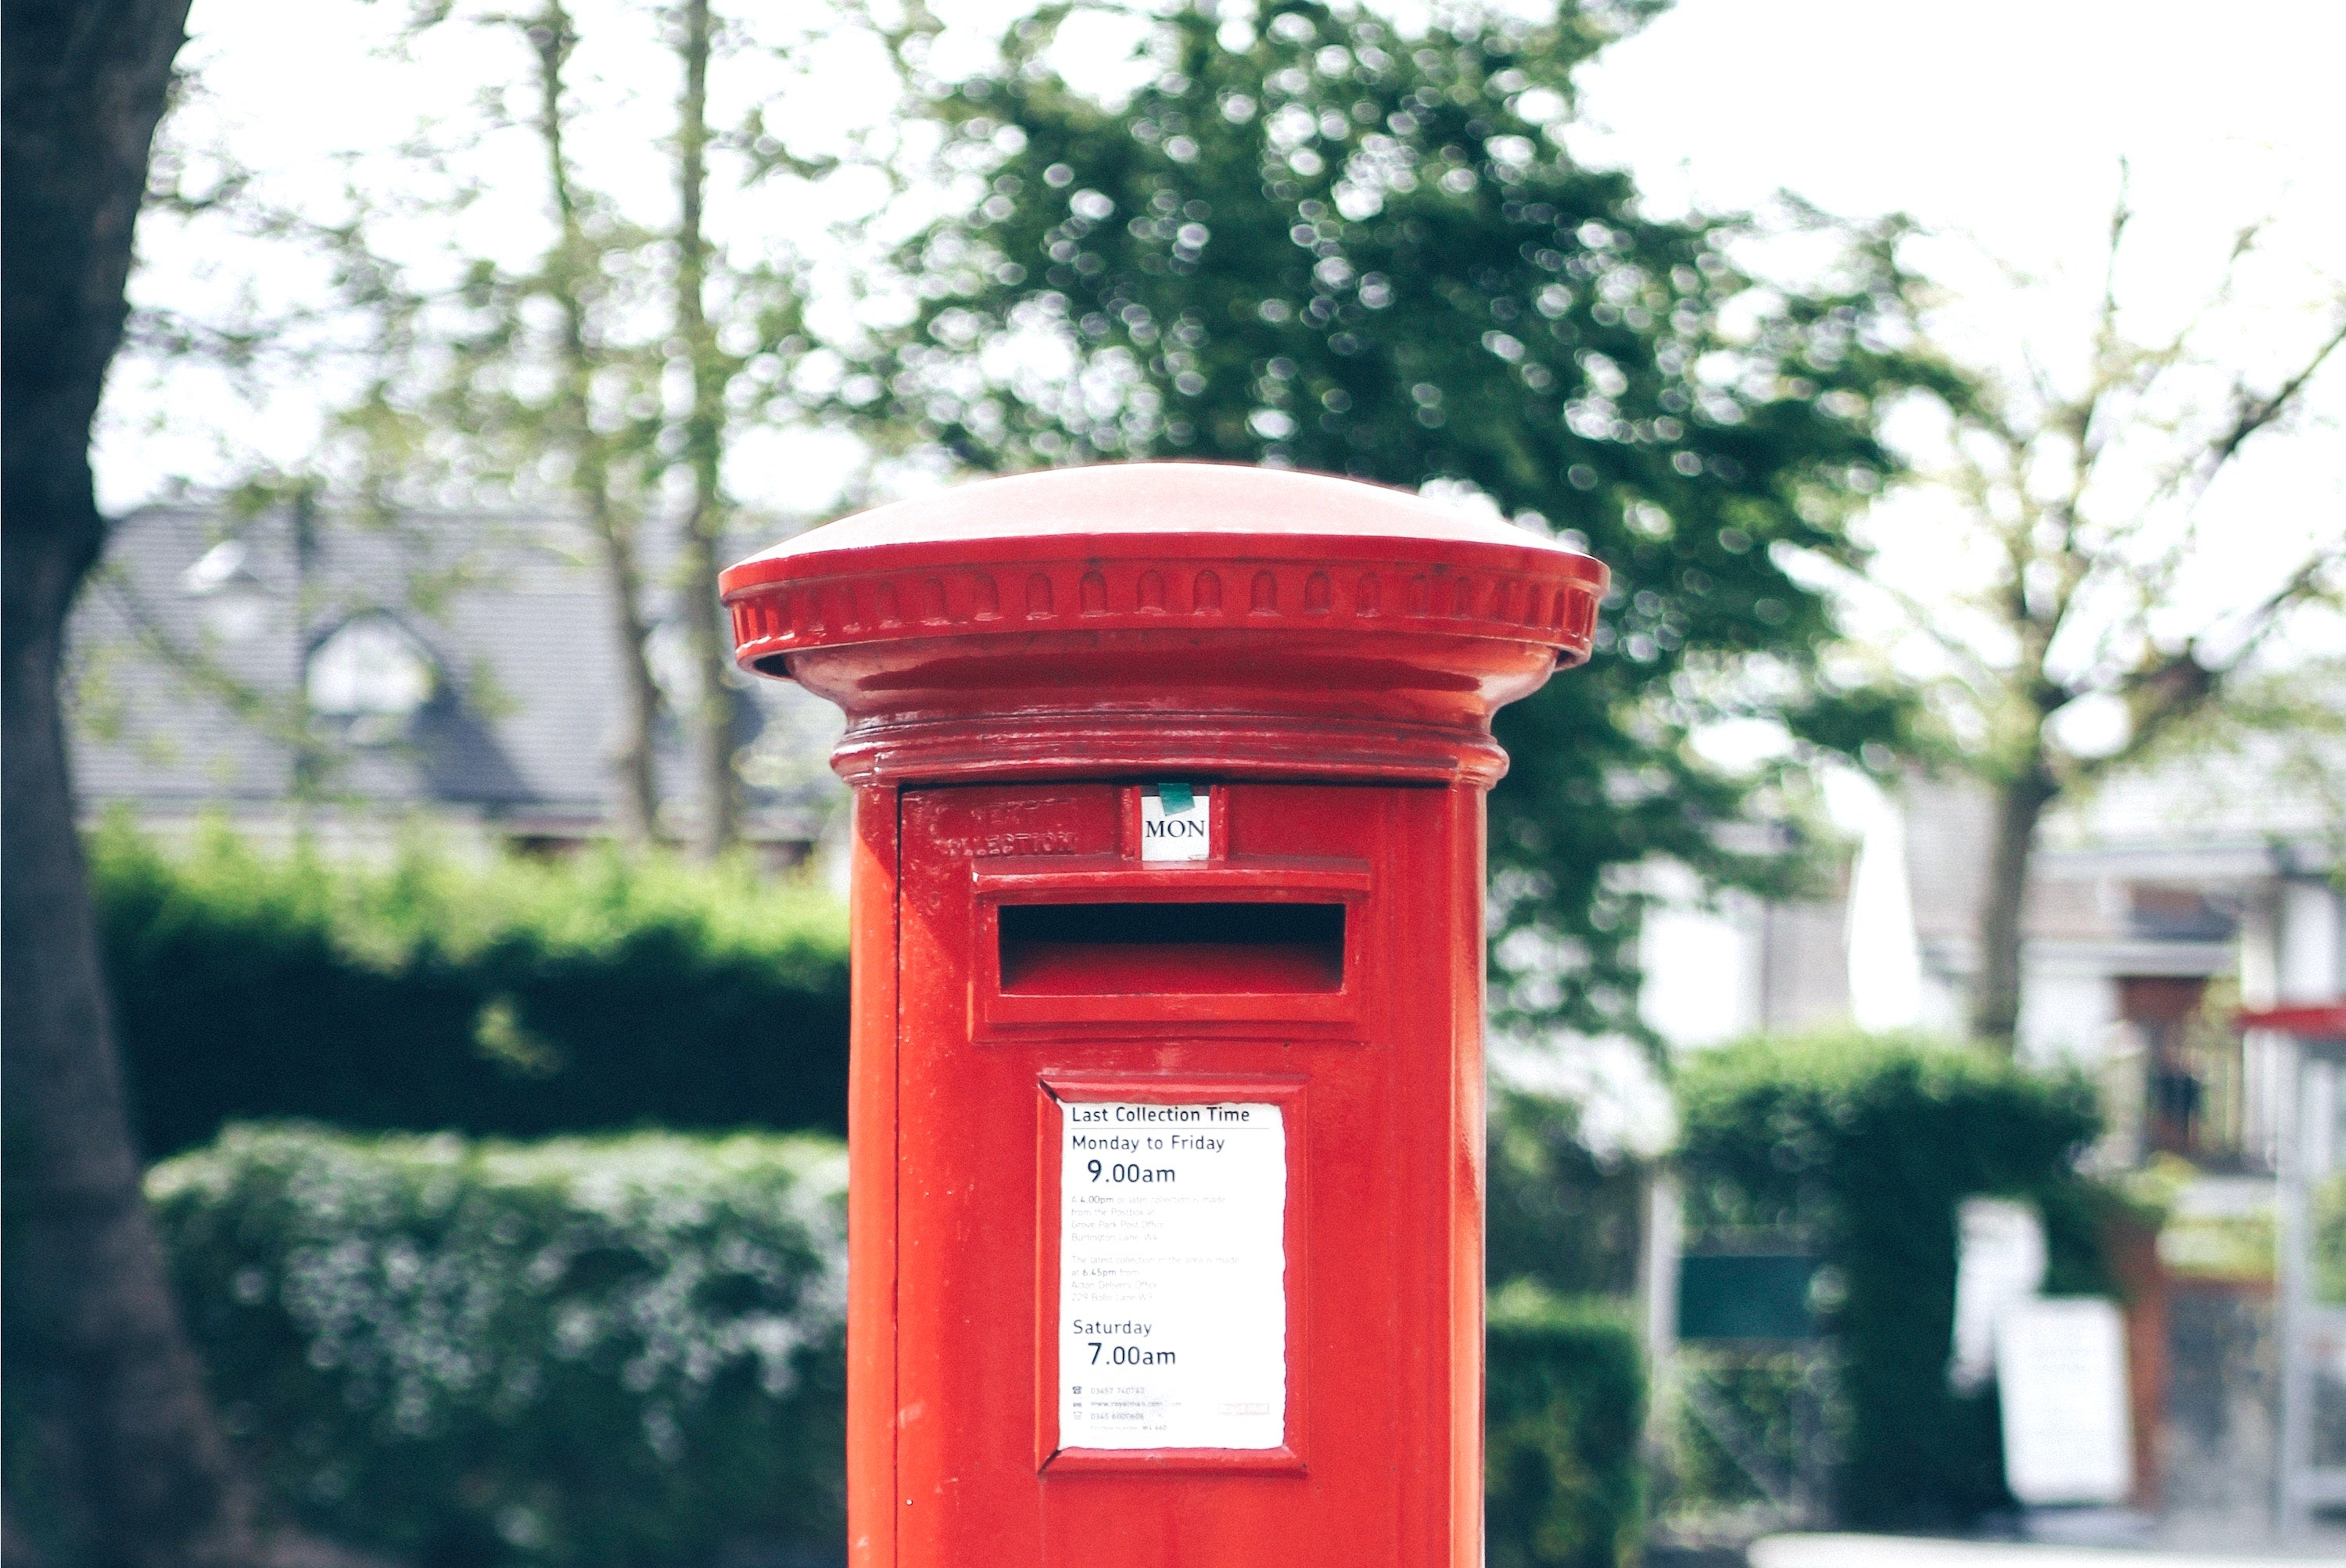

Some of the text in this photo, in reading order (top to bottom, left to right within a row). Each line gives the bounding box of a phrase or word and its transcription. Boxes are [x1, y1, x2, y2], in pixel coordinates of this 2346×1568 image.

[1145, 820, 1205, 838] MON
[1071, 1107, 1250, 1121] Last Collection Time
[1072, 1136, 1225, 1153] Monday to Friday
[1087, 1159, 1176, 1182] 9.00am
[1081, 1196, 1114, 1204] 4.00pm
[1082, 1268, 1117, 1278] 6.45pm
[1073, 1320, 1153, 1337] Saturday
[1088, 1342, 1176, 1365] 7.00am
